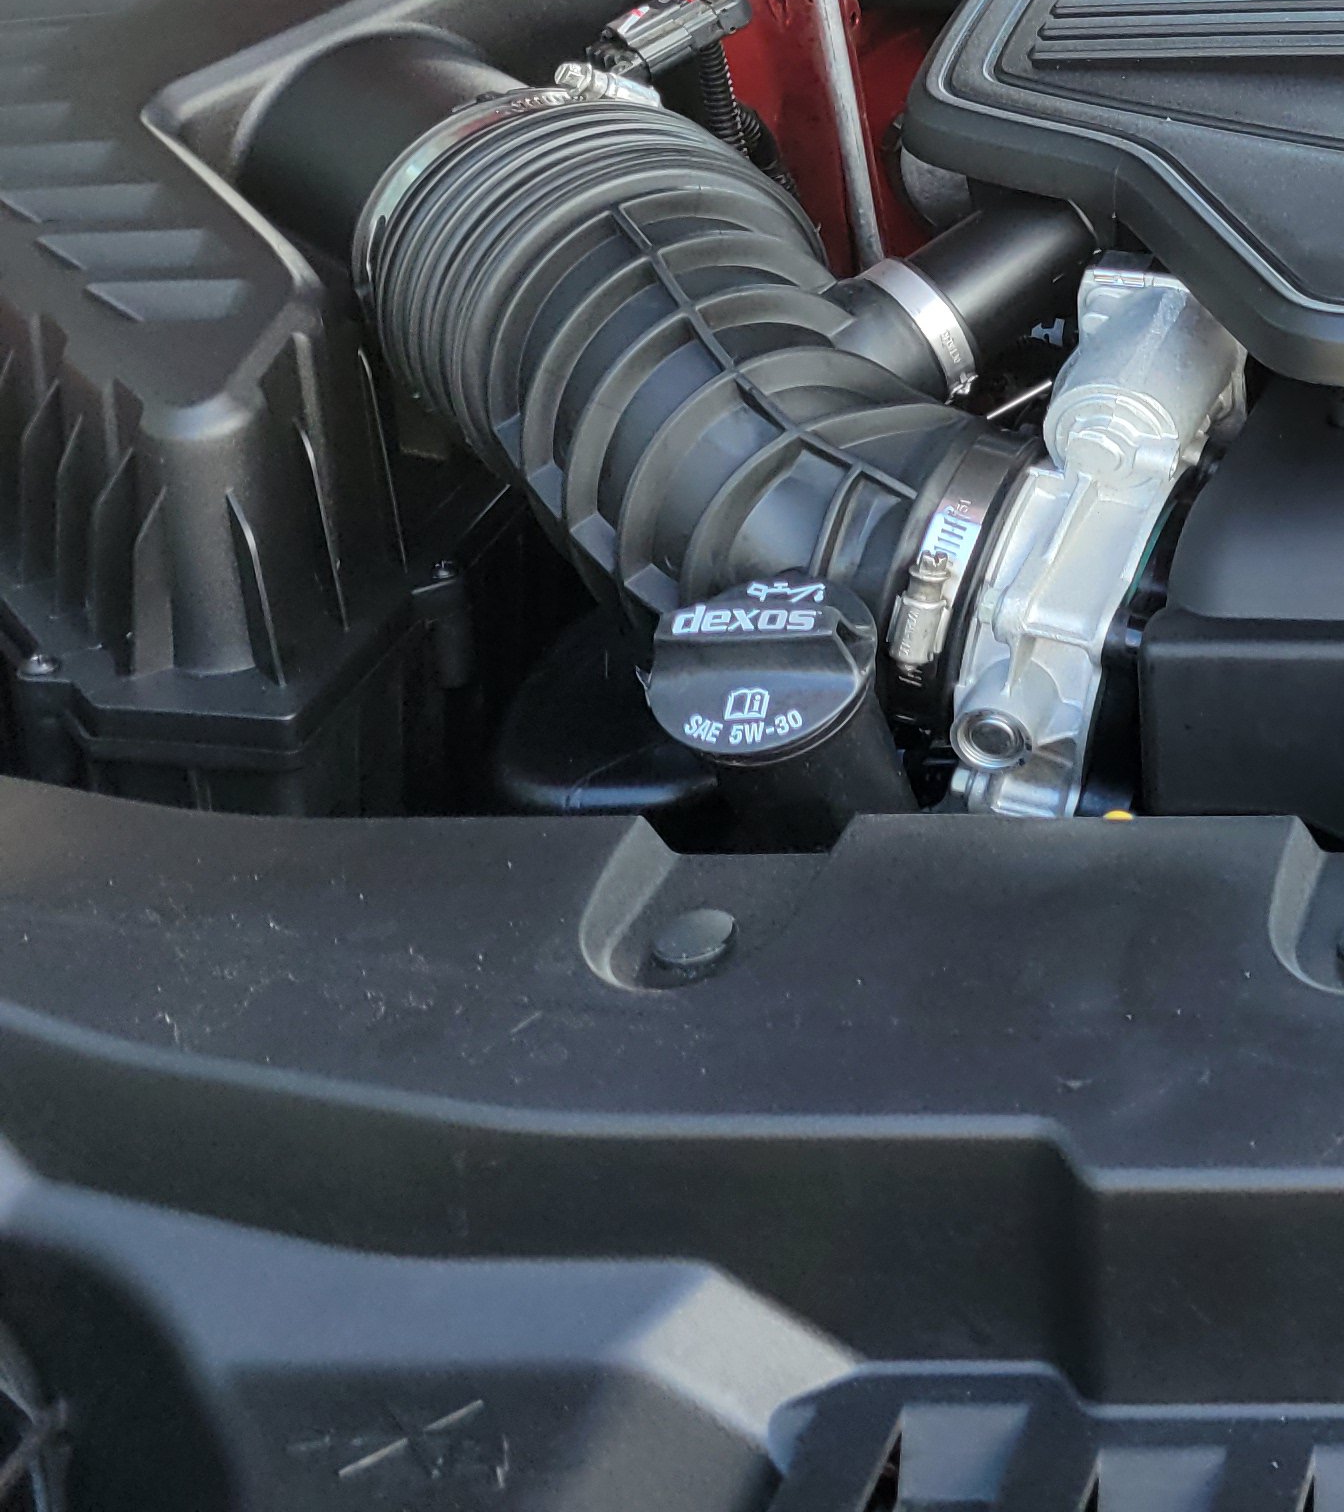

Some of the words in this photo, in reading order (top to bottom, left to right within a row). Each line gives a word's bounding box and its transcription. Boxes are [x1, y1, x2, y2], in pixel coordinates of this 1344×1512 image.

[671, 603, 817, 635] dexos
[683, 713, 724, 744] SAE
[729, 709, 803, 745] 5W-30
